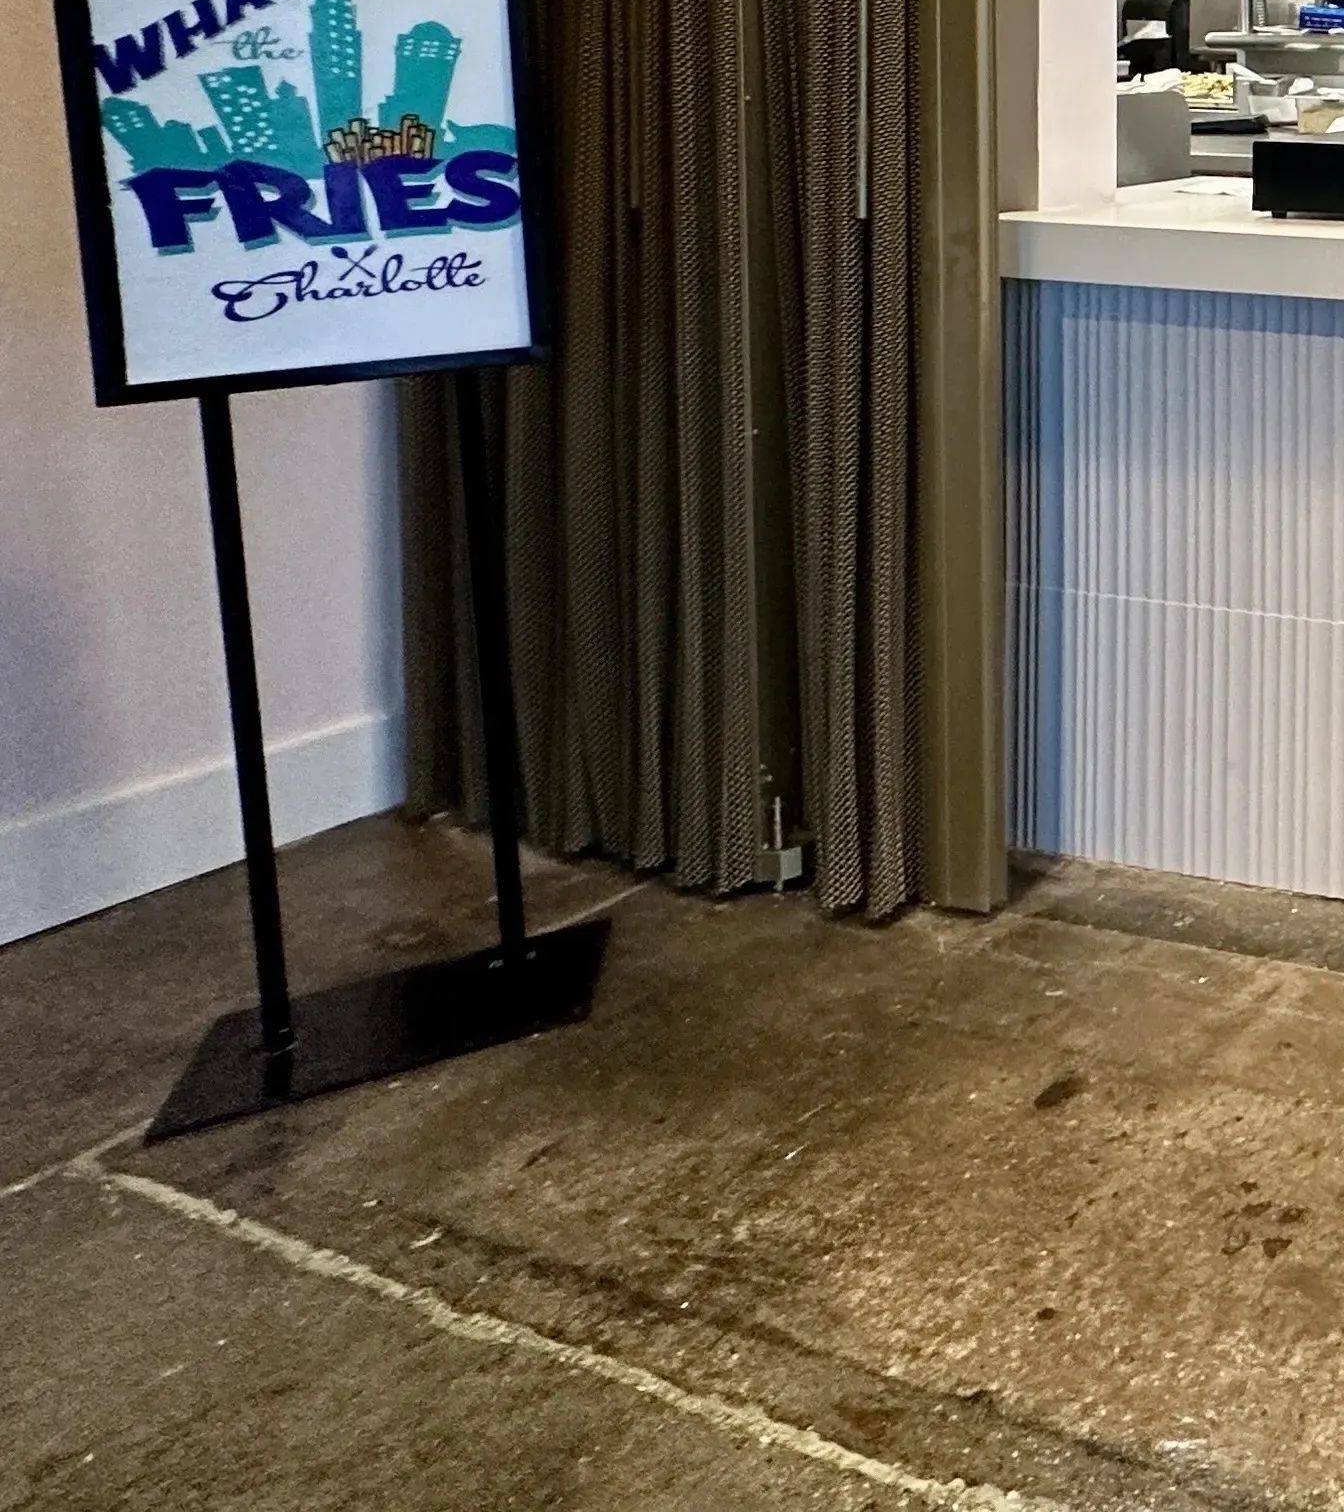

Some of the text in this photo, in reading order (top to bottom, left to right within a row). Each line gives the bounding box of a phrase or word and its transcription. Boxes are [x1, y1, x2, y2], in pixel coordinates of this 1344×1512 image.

[210, 26, 304, 61] the
[125, 150, 522, 255] FRIES
[212, 252, 487, 322] Charlotte
